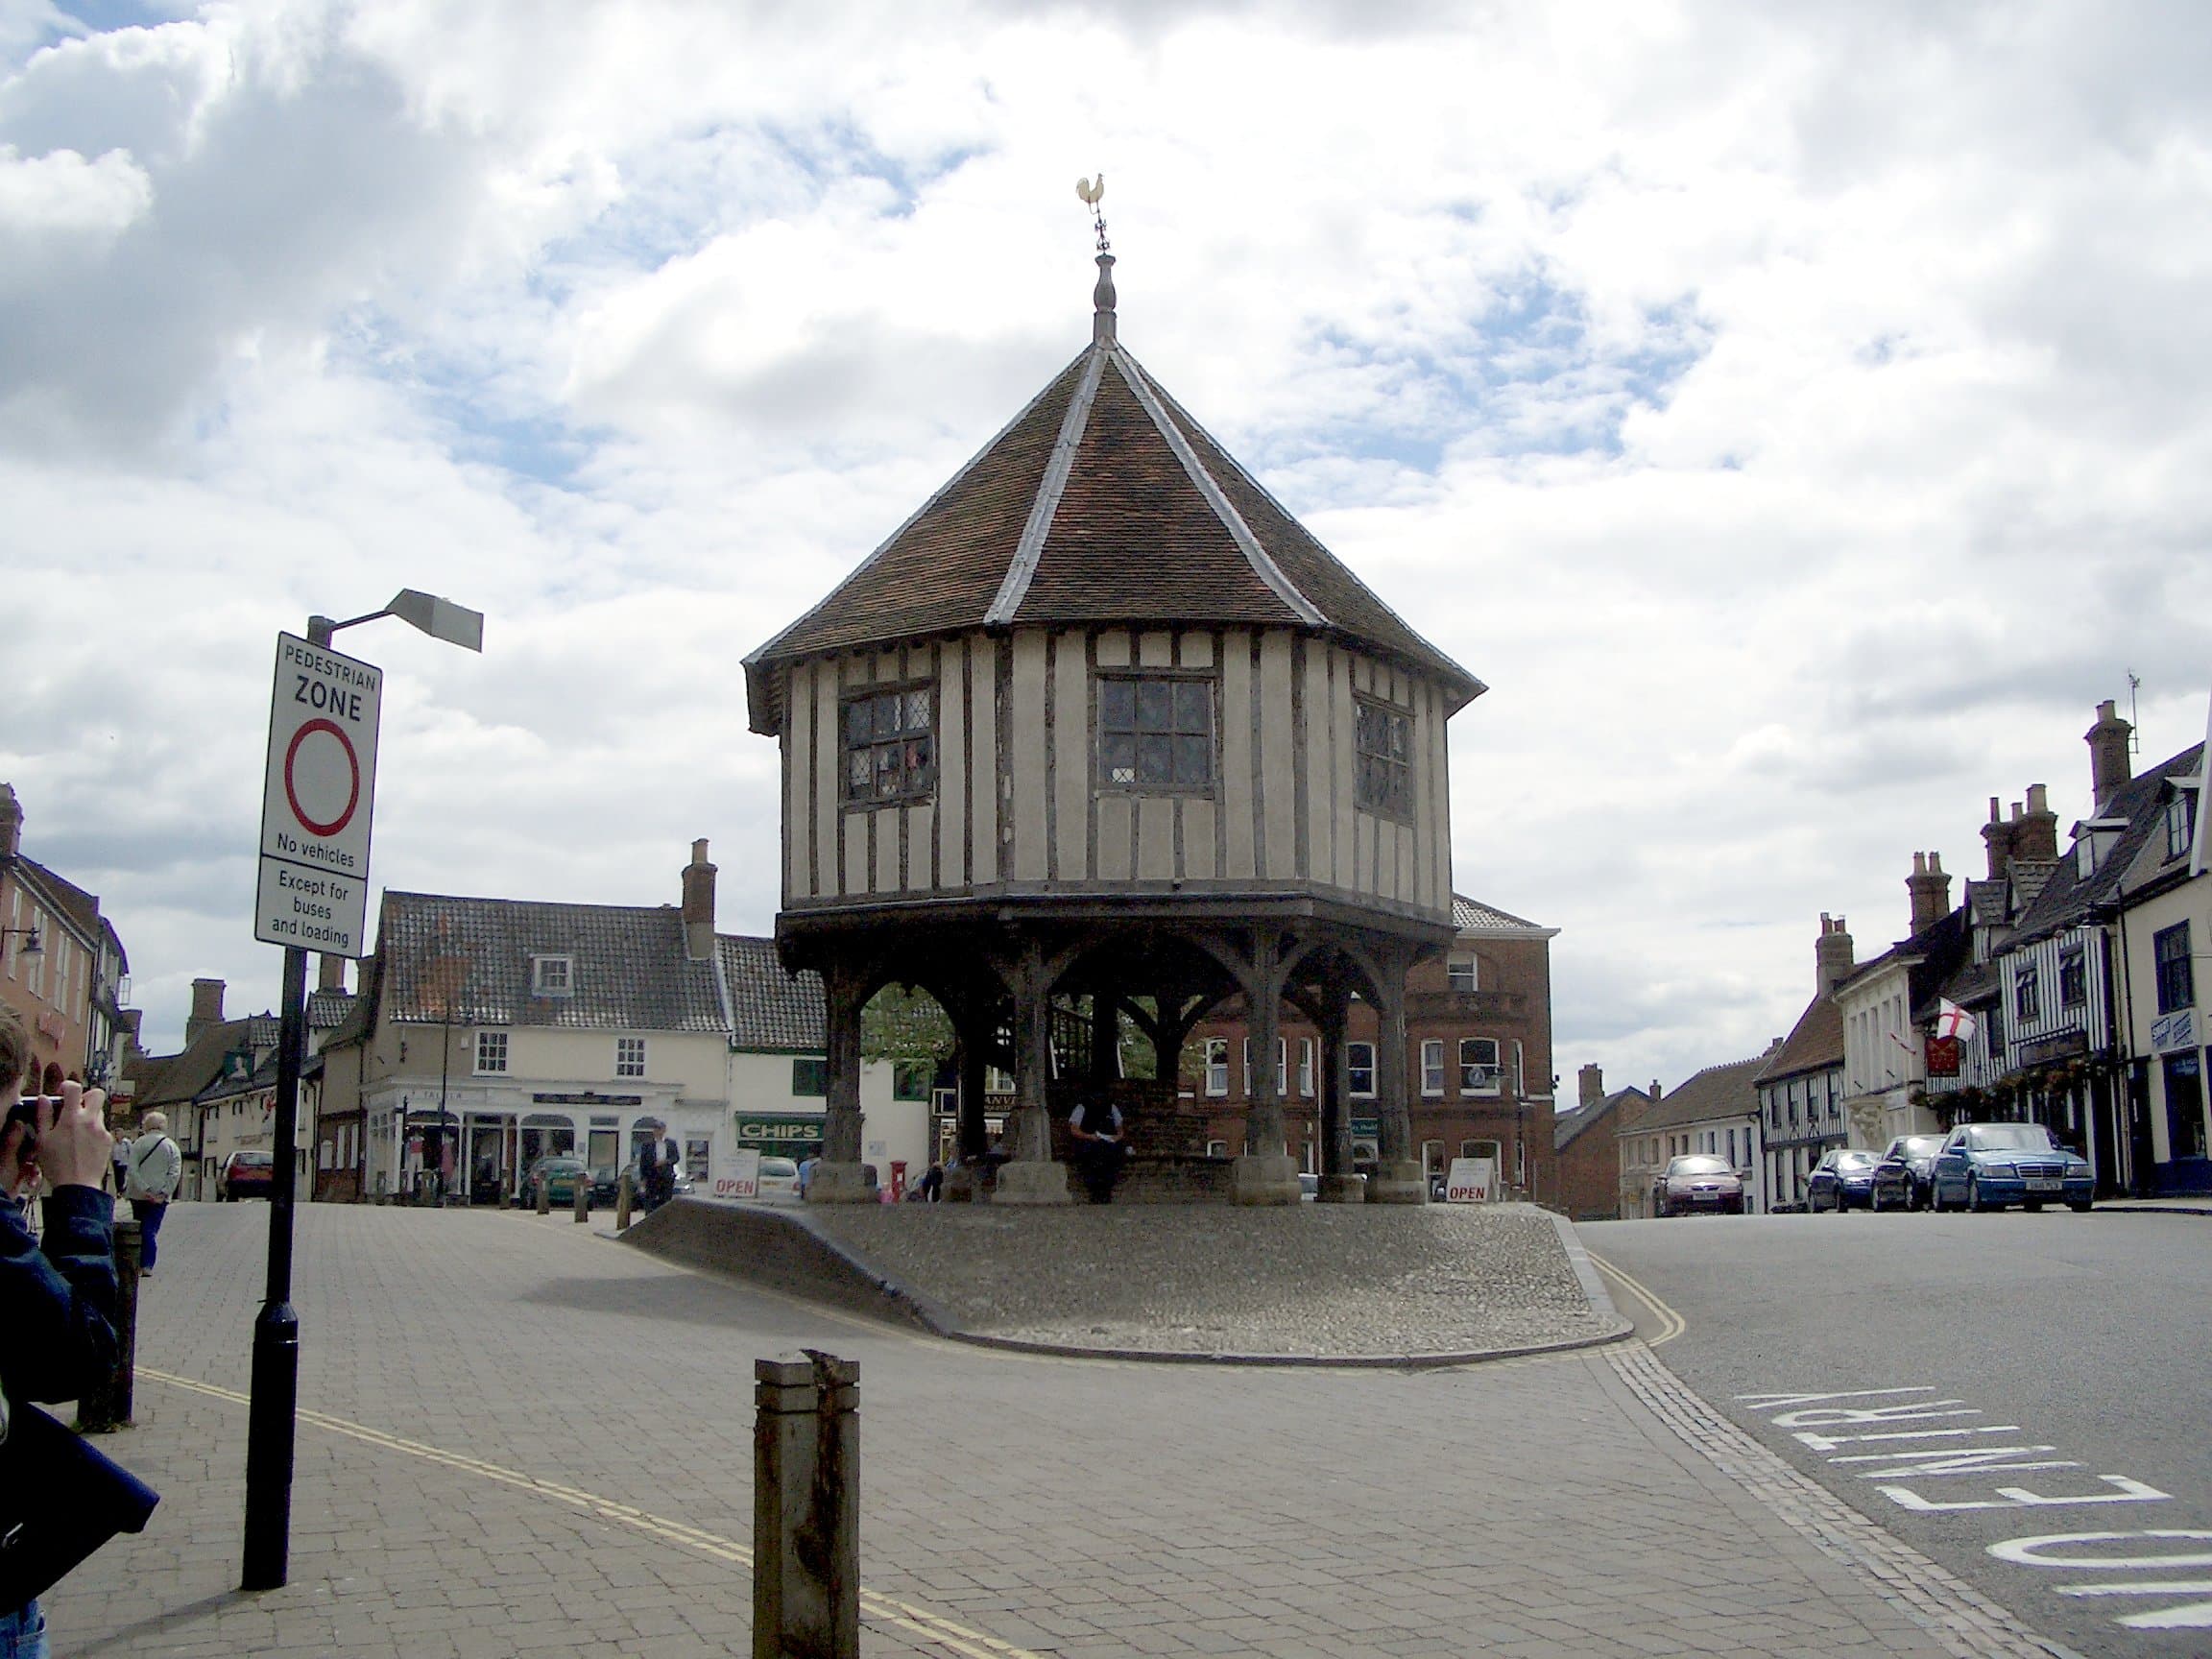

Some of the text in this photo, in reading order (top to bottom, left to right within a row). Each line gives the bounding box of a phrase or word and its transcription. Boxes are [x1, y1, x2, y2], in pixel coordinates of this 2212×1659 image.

[284, 644, 376, 692] PEDESTRIAN
[294, 673, 363, 723] ZONE
[277, 832, 355, 868] No vehicles
[278, 869, 349, 902] Except for
[294, 895, 332, 921] buses
[271, 918, 349, 950] and loading
[741, 1122, 819, 1139] CHIPS
[715, 1178, 755, 1194] OPEN
[1450, 1186, 1485, 1199] OPEN
[1734, 1385, 2175, 1512] ENTRY
